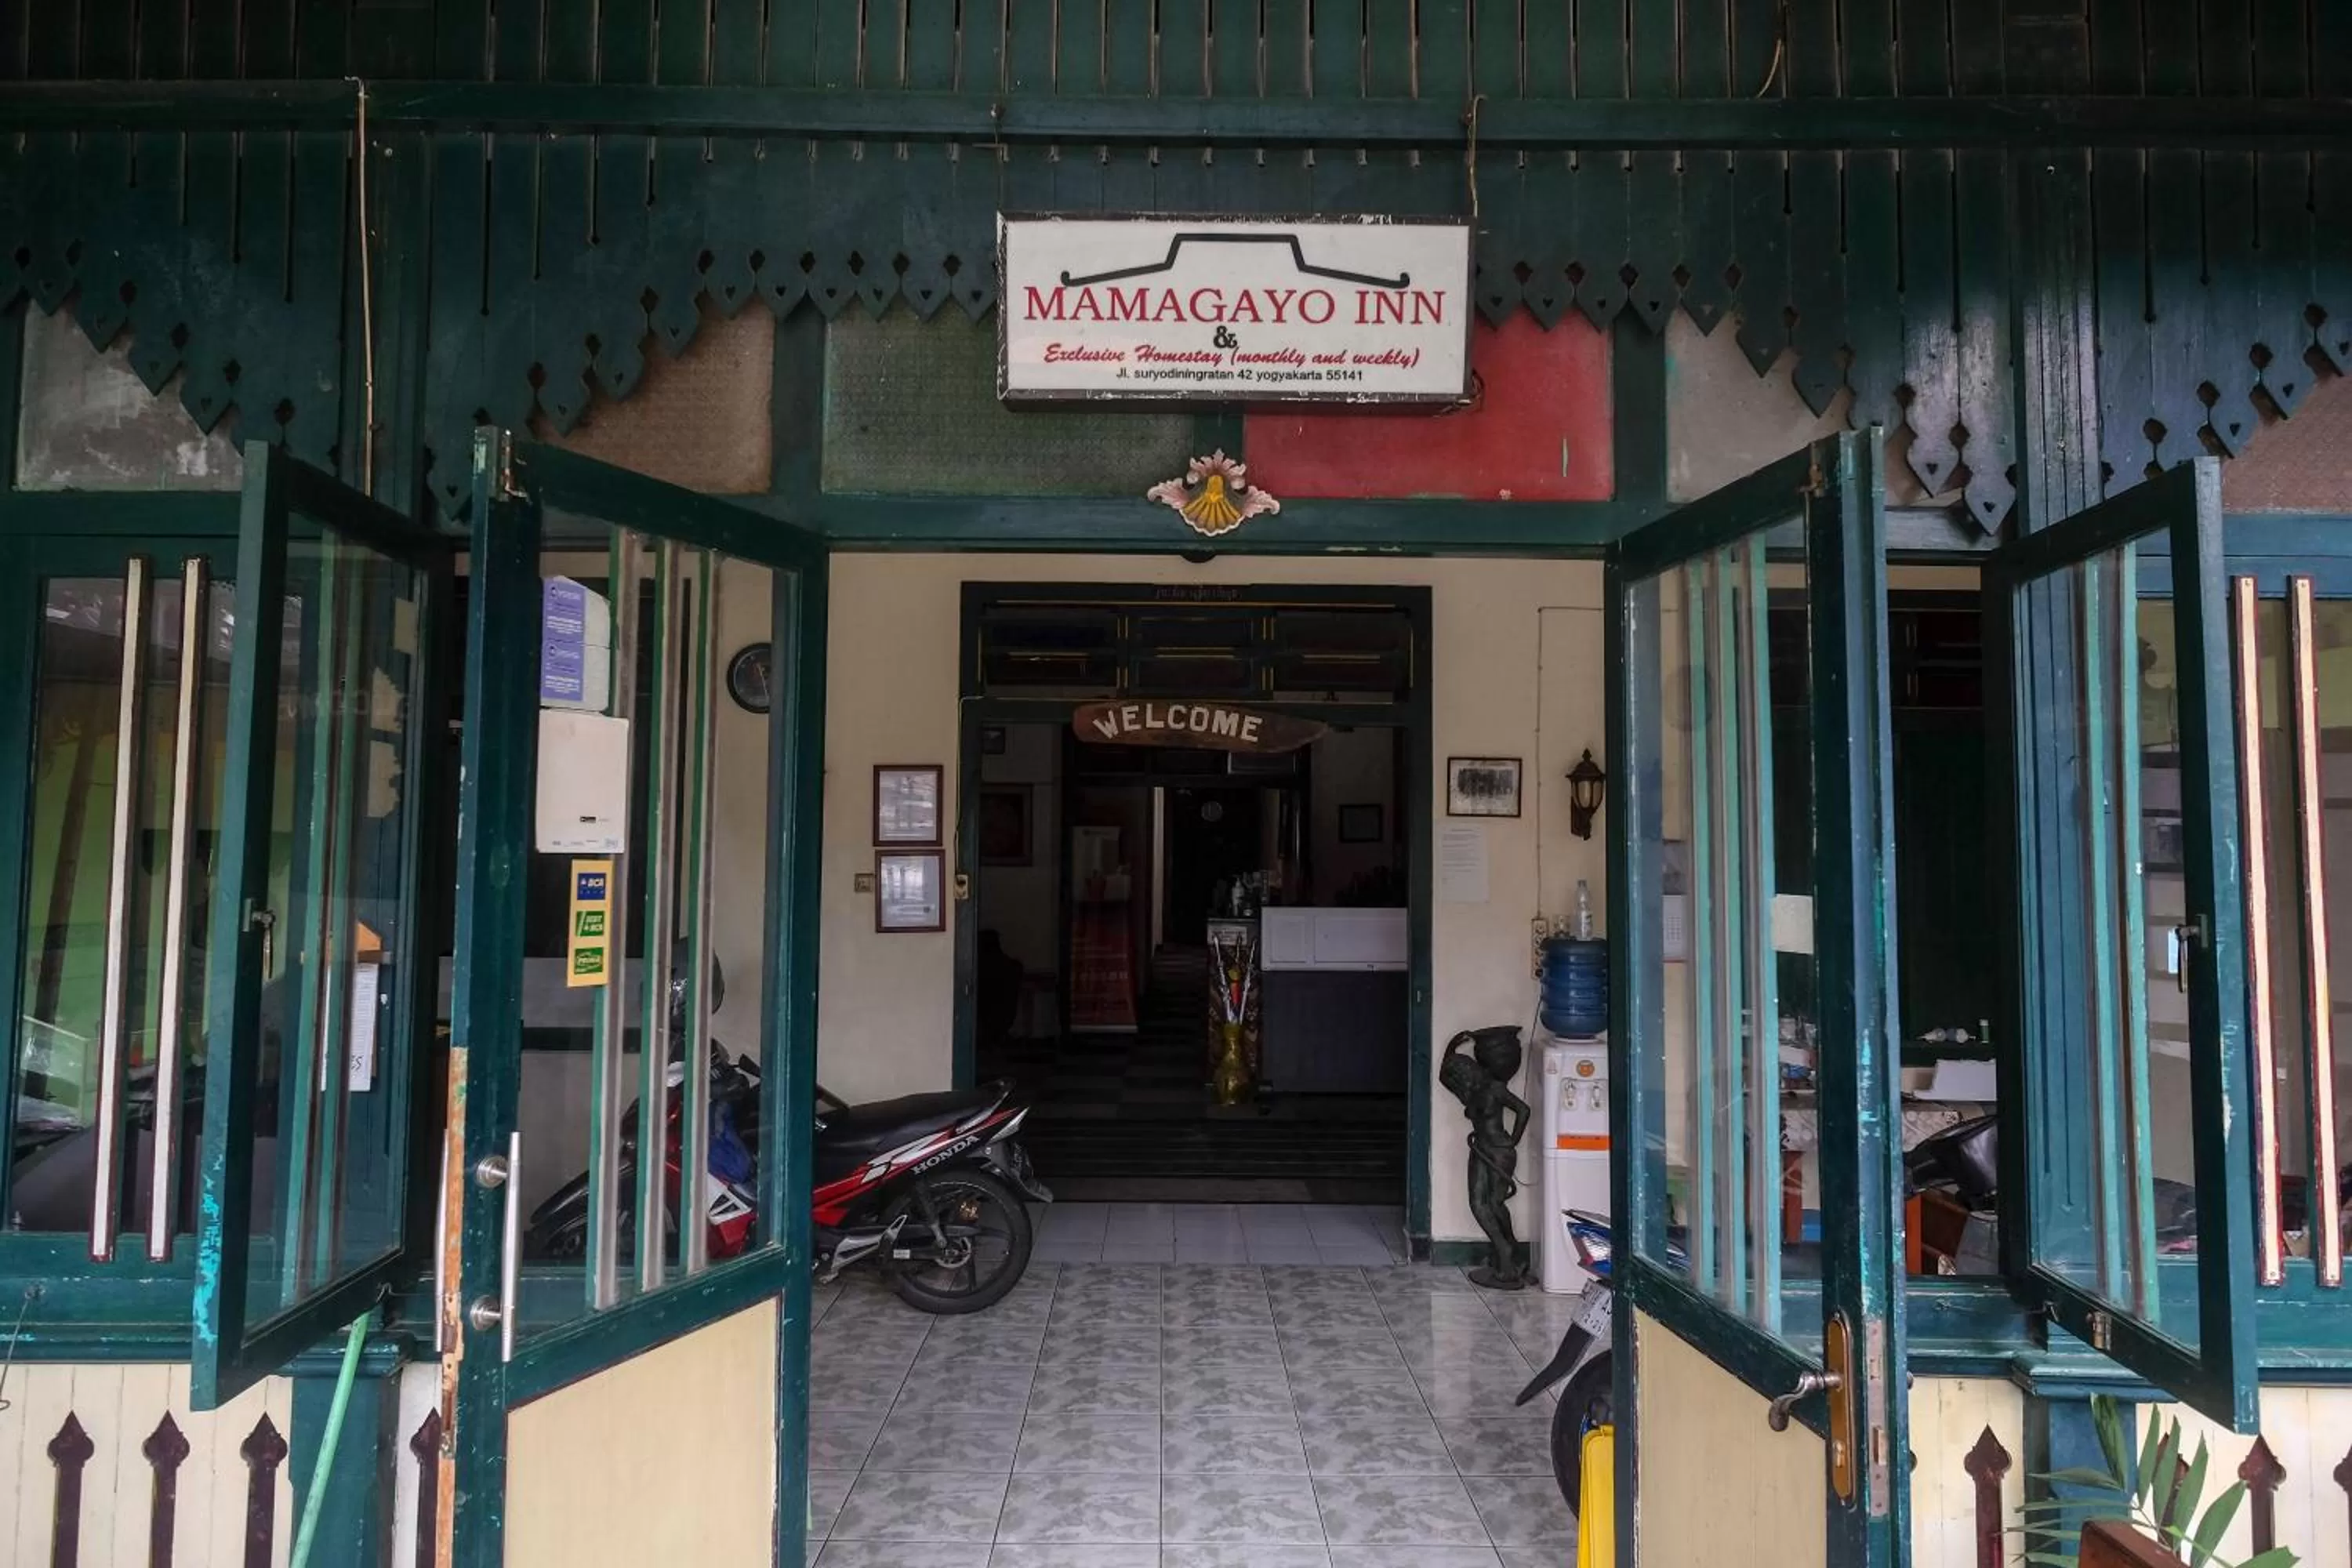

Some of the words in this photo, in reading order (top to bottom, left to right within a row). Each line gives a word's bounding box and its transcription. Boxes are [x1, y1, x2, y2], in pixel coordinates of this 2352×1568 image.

[1023, 286, 1336, 324] MAMAGAYO
[1354, 290, 1446, 325] INN
[1213, 325, 1238, 349] &
[1044, 343, 1126, 363] Exclusive
[1134, 344, 1222, 367] Homestay
[1231, 347, 1306, 368] (monthly
[1312, 349, 1348, 364] and
[1352, 347, 1421, 368] weekly)
[1134, 367, 1234, 382] suryodiningratan
[1236, 370, 1254, 380] 42
[1256, 369, 1323, 383] yogyakarta
[1326, 370, 1363, 382] 55141
[1092, 702, 1263, 742] WELCOME
[910, 1134, 979, 1175] HONDA
